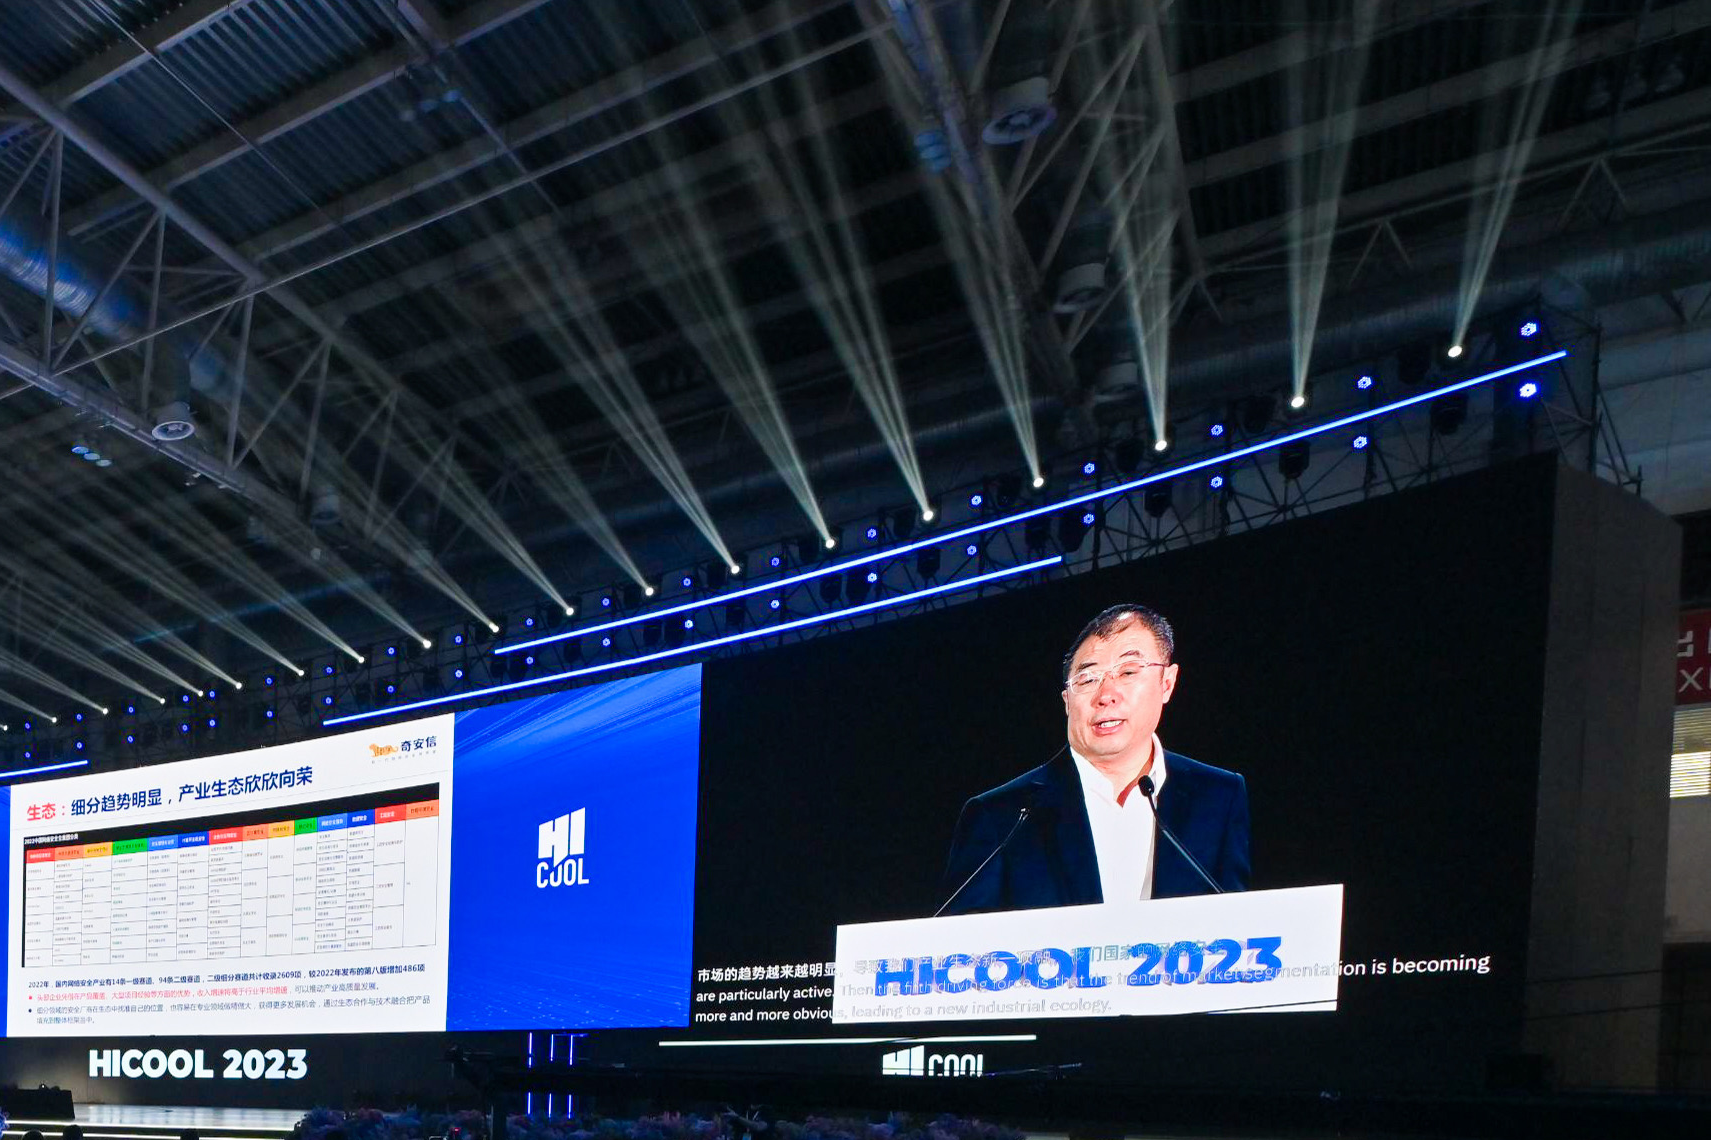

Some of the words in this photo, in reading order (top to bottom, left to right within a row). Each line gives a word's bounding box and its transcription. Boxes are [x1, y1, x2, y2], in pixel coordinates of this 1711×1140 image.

[401, 736, 436, 752] 奇安信
[696, 992, 715, 1002] are
[719, 986, 790, 1003] particularly
[1372, 959, 1386, 974] is
[1392, 954, 1490, 974] becoming
[875, 947, 1106, 996] HICOOL
[1127, 936, 1282, 986] 2023
[696, 1012, 726, 1022] more
[730, 1009, 752, 1021] and
[757, 1010, 790, 1021] more
[937, 1003, 968, 1014] new
[972, 999, 1045, 1014] industrial
[88, 1050, 213, 1078] HICOOL
[223, 1049, 307, 1079] 2023
